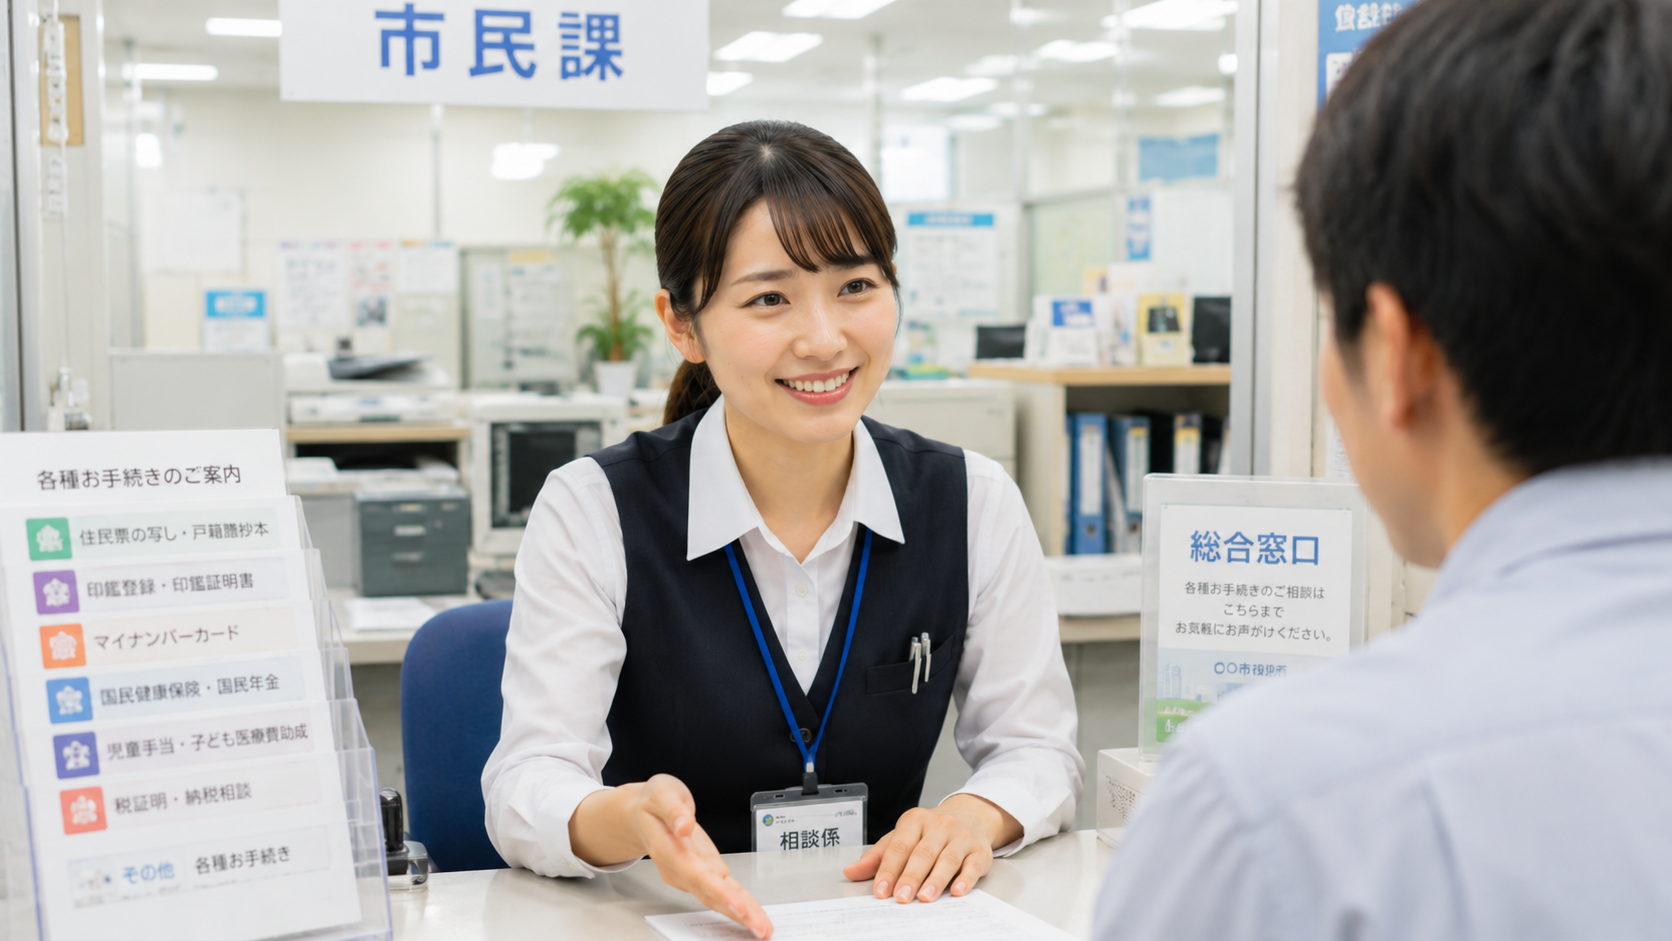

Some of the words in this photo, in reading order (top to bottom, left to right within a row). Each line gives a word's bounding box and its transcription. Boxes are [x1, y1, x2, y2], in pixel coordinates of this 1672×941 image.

[375, 3, 624, 81] 市民課
[37, 464, 242, 490] 各種お手続きのご案内
[1190, 531, 1319, 566] 総合窓口
[87, 572, 253, 599] 印鑑登録・印鑑証明書
[1184, 582, 1325, 600] 各種お手続きのご相談は
[1223, 603, 1285, 618] こちらまで
[94, 625, 240, 650] マイナンバーカード
[1175, 622, 1332, 642] お気軽にお声がけください。
[101, 674, 281, 706] 国民健康保険・国民年金
[107, 724, 309, 760] 児童手当・子ども医療費助成
[114, 783, 252, 814] 税証明・納税相談
[780, 827, 840, 850] 相談係
[122, 863, 175, 885] その他
[195, 846, 291, 875] 各種お手続き
